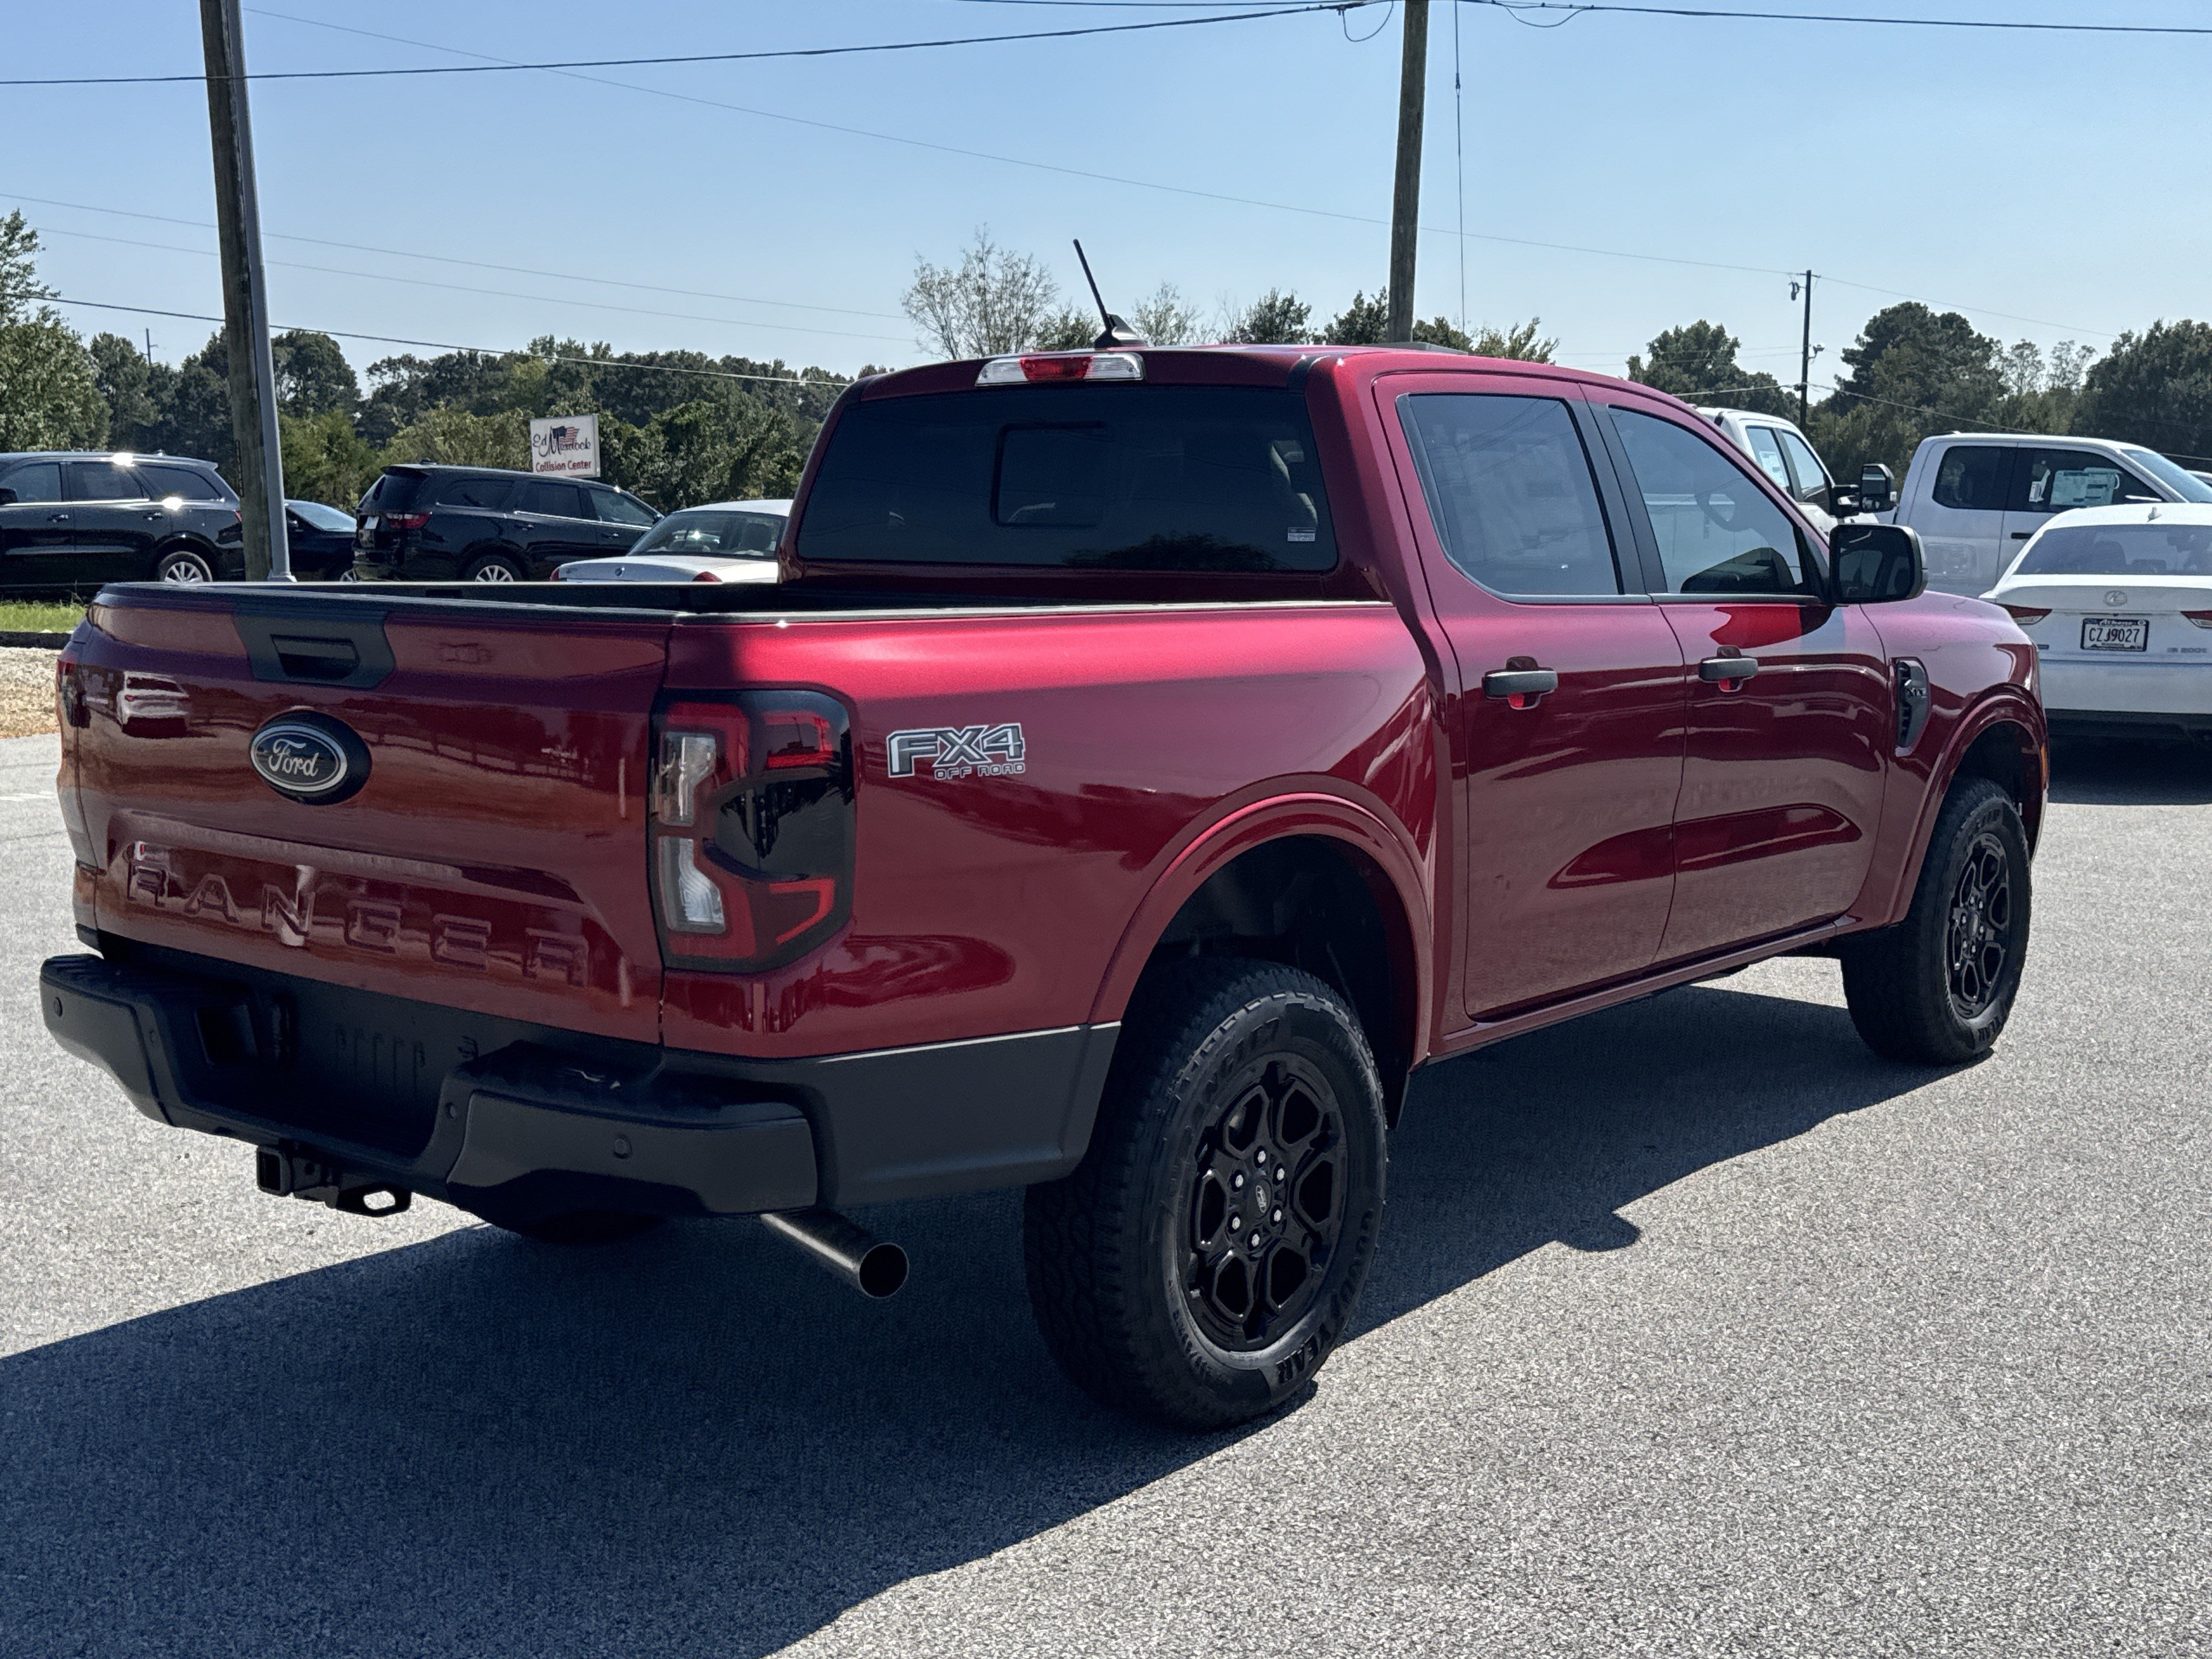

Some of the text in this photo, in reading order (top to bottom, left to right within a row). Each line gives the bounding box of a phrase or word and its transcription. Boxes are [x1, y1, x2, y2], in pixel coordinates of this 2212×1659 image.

[532, 426, 591, 458] Ed Murdock
[535, 460, 592, 473] Collision Center
[2089, 627, 2140, 643] CZJ9027
[268, 738, 319, 777] Ford
[886, 723, 1025, 778] FX4
[934, 763, 1026, 781] OFF ROAD
[127, 862, 590, 987] RANGER
